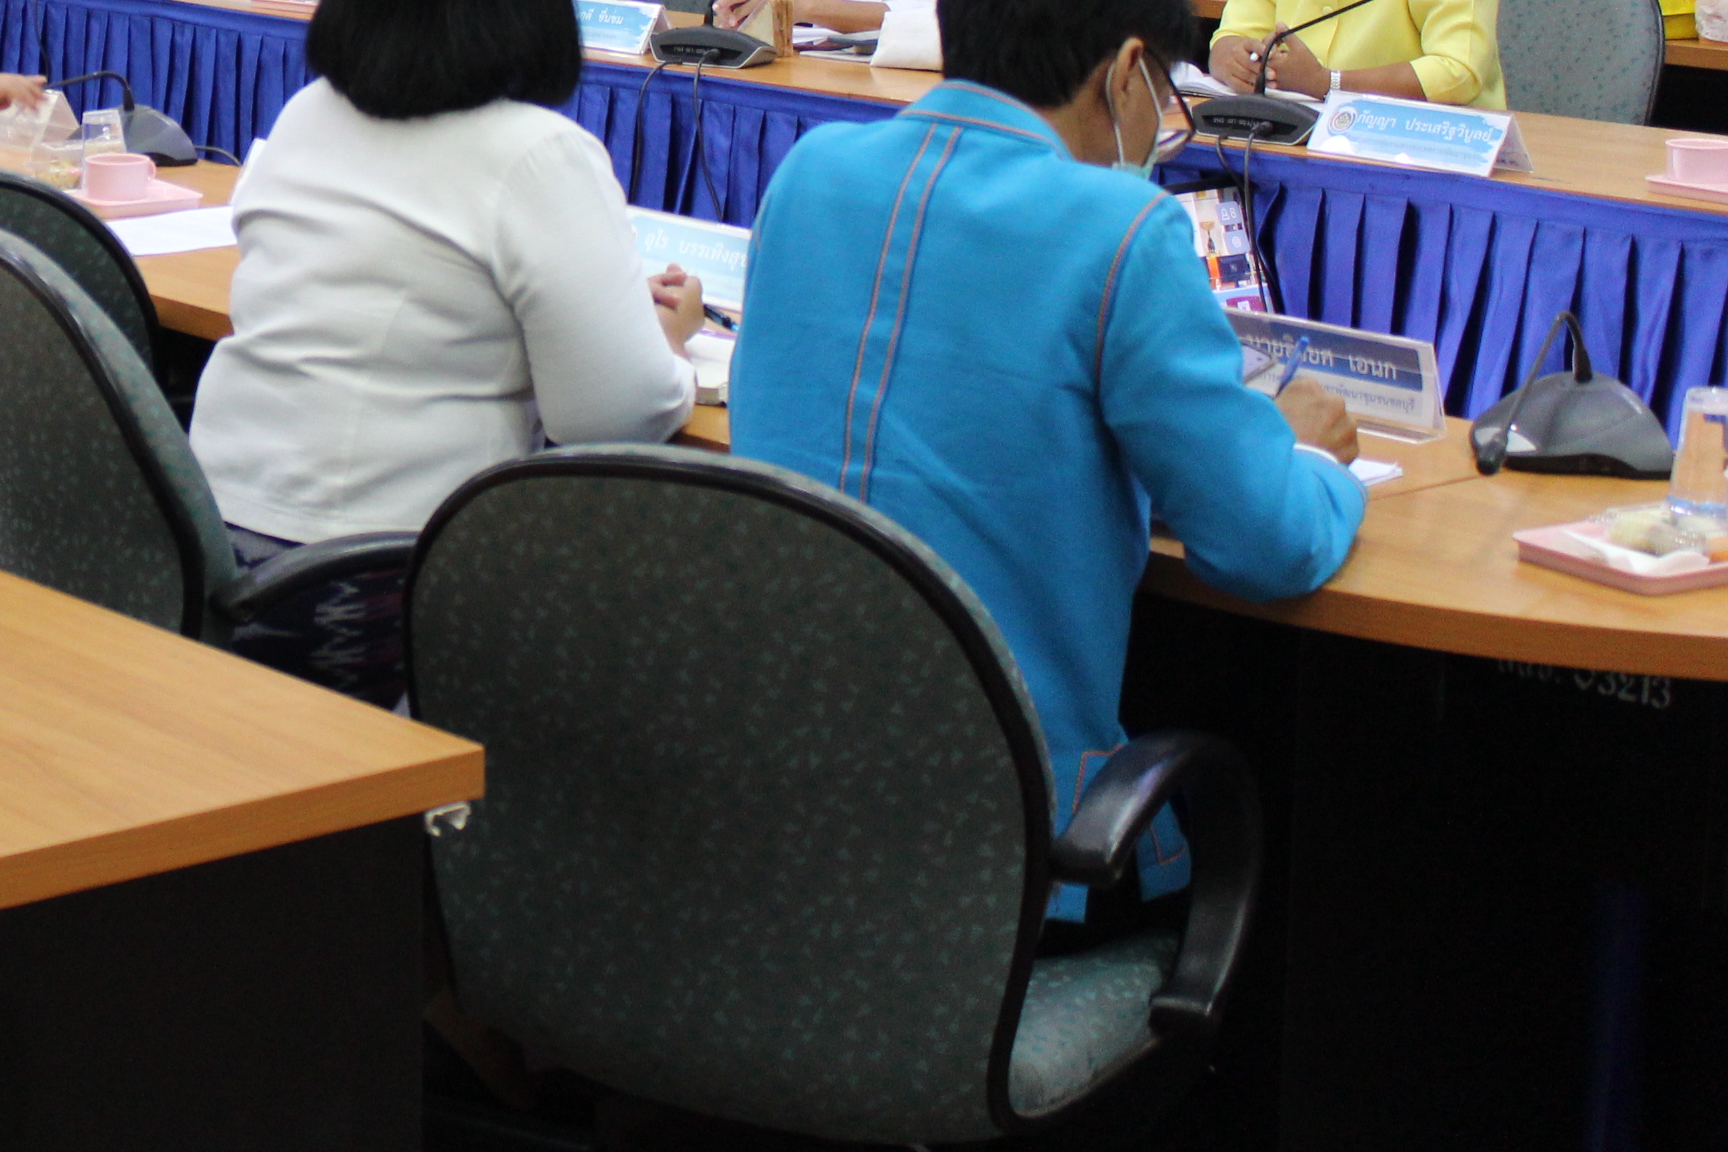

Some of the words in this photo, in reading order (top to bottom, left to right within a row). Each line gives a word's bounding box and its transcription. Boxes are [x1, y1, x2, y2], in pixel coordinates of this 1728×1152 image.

[1404, 116, 1493, 144] ประเสริฐวิบูลย์
[1347, 354, 1398, 381] เอนก
